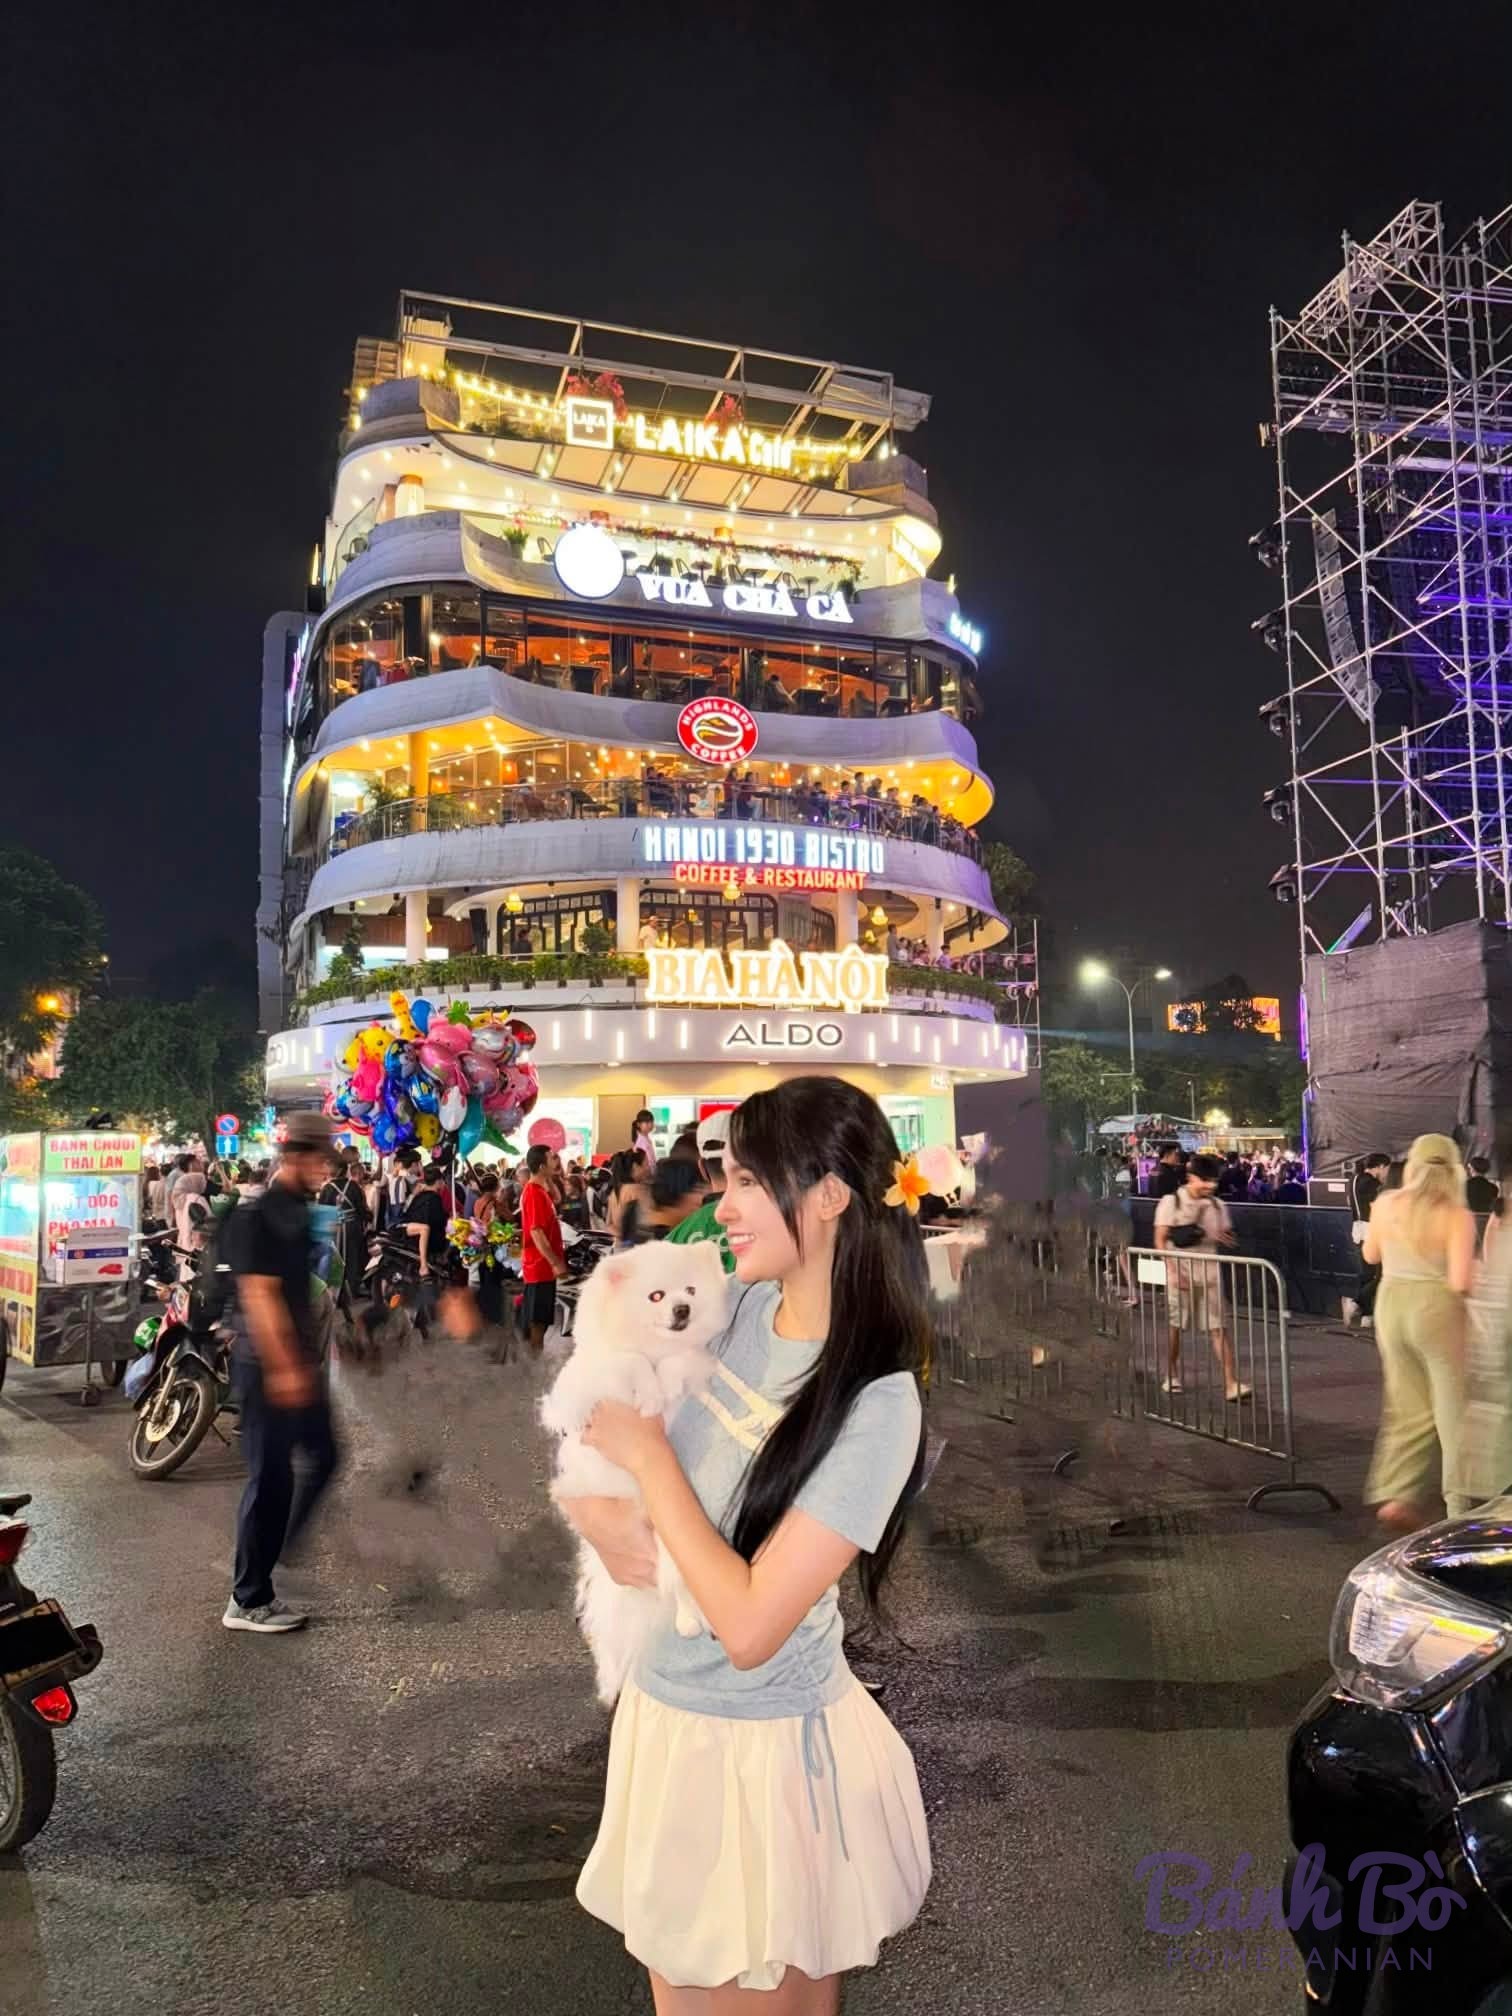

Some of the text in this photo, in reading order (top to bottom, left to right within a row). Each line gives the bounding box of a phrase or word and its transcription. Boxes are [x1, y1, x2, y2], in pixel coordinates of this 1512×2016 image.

[634, 413, 746, 465] LAIKA
[636, 572, 713, 608] VUA
[681, 701, 754, 731] HIGHLANDS
[690, 742, 746, 761] COFFEE
[644, 825, 886, 875] HANOI 1930 BISTRO
[675, 863, 867, 890] COFFEE & RESTAURANT
[648, 948, 733, 1002] BIA
[727, 1023, 843, 1046] ALDO
[88, 1194, 119, 1209] DOG
